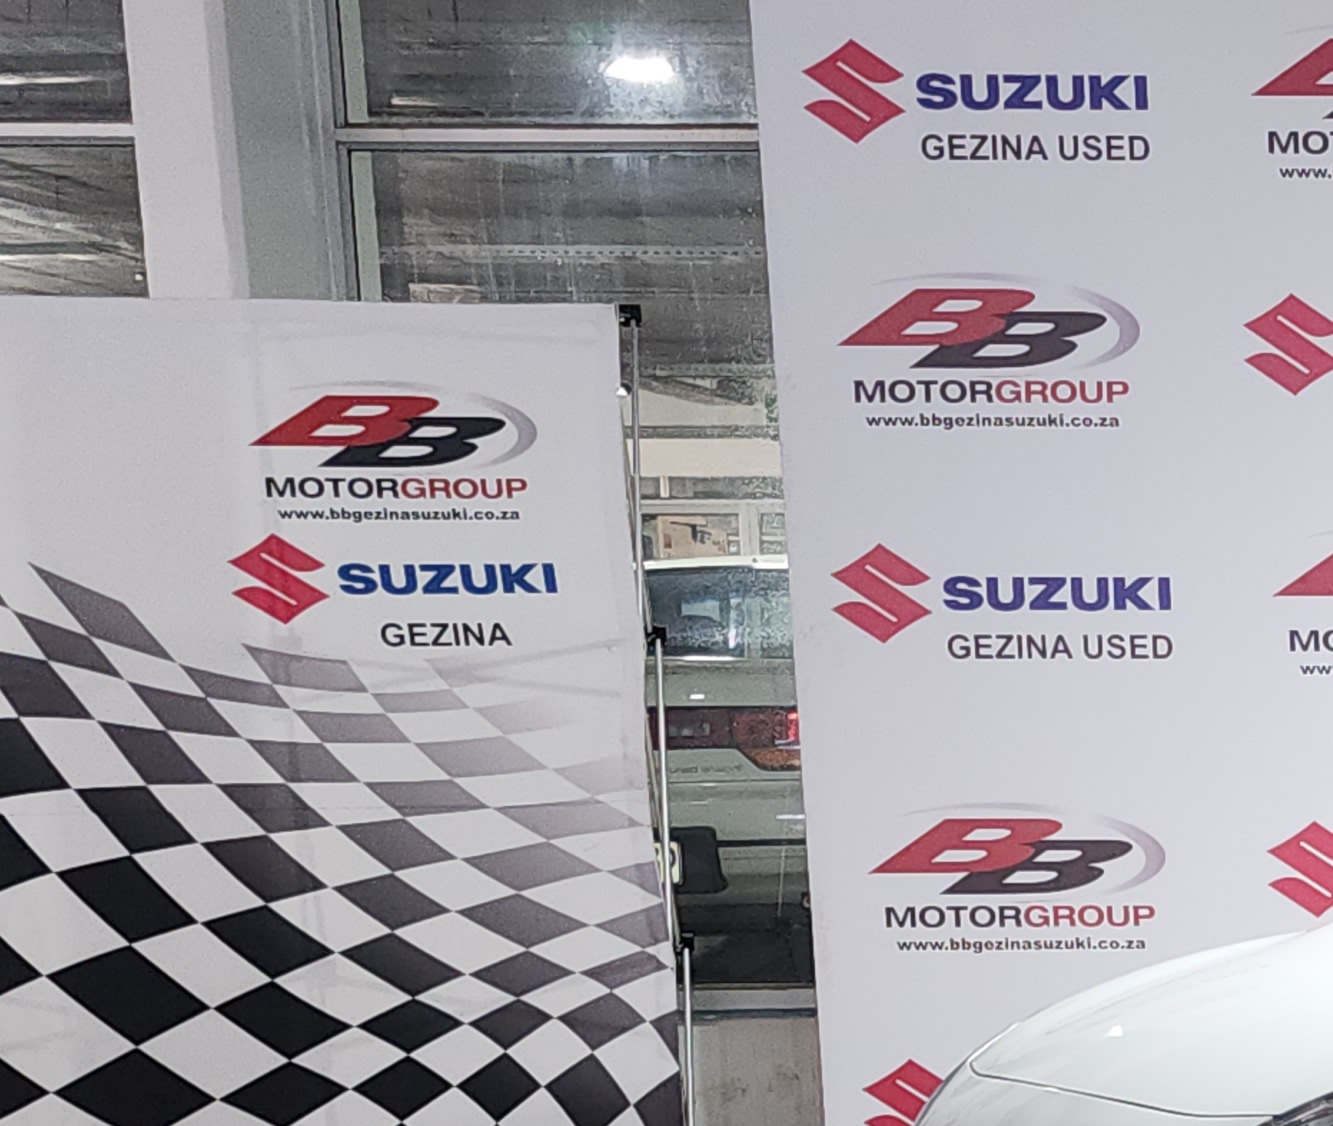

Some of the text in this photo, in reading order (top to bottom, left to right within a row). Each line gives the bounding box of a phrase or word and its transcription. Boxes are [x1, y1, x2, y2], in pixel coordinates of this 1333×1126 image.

[916, 73, 1148, 110] SUZUKI
[922, 134, 1150, 160] GEZINA USED
[838, 289, 1107, 368] BB
[854, 380, 1129, 403] MOTORGROUP
[250, 395, 506, 467] BB
[866, 413, 1119, 430] www.bbgezinasuzuki.co.za
[265, 477, 527, 499] MOTORGROUP
[277, 508, 520, 523] www.bbgezinasuzuki.co.za
[338, 563, 557, 595] SUZUKI
[943, 576, 1171, 611] SUZUKI
[381, 623, 512, 647] GEZINA
[948, 634, 1173, 659] GEZINA USED
[869, 819, 1133, 894] BB
[885, 905, 1155, 928] MOTORGROUP
[897, 937, 1145, 953] www.bbgezinasuzuki.co.za
